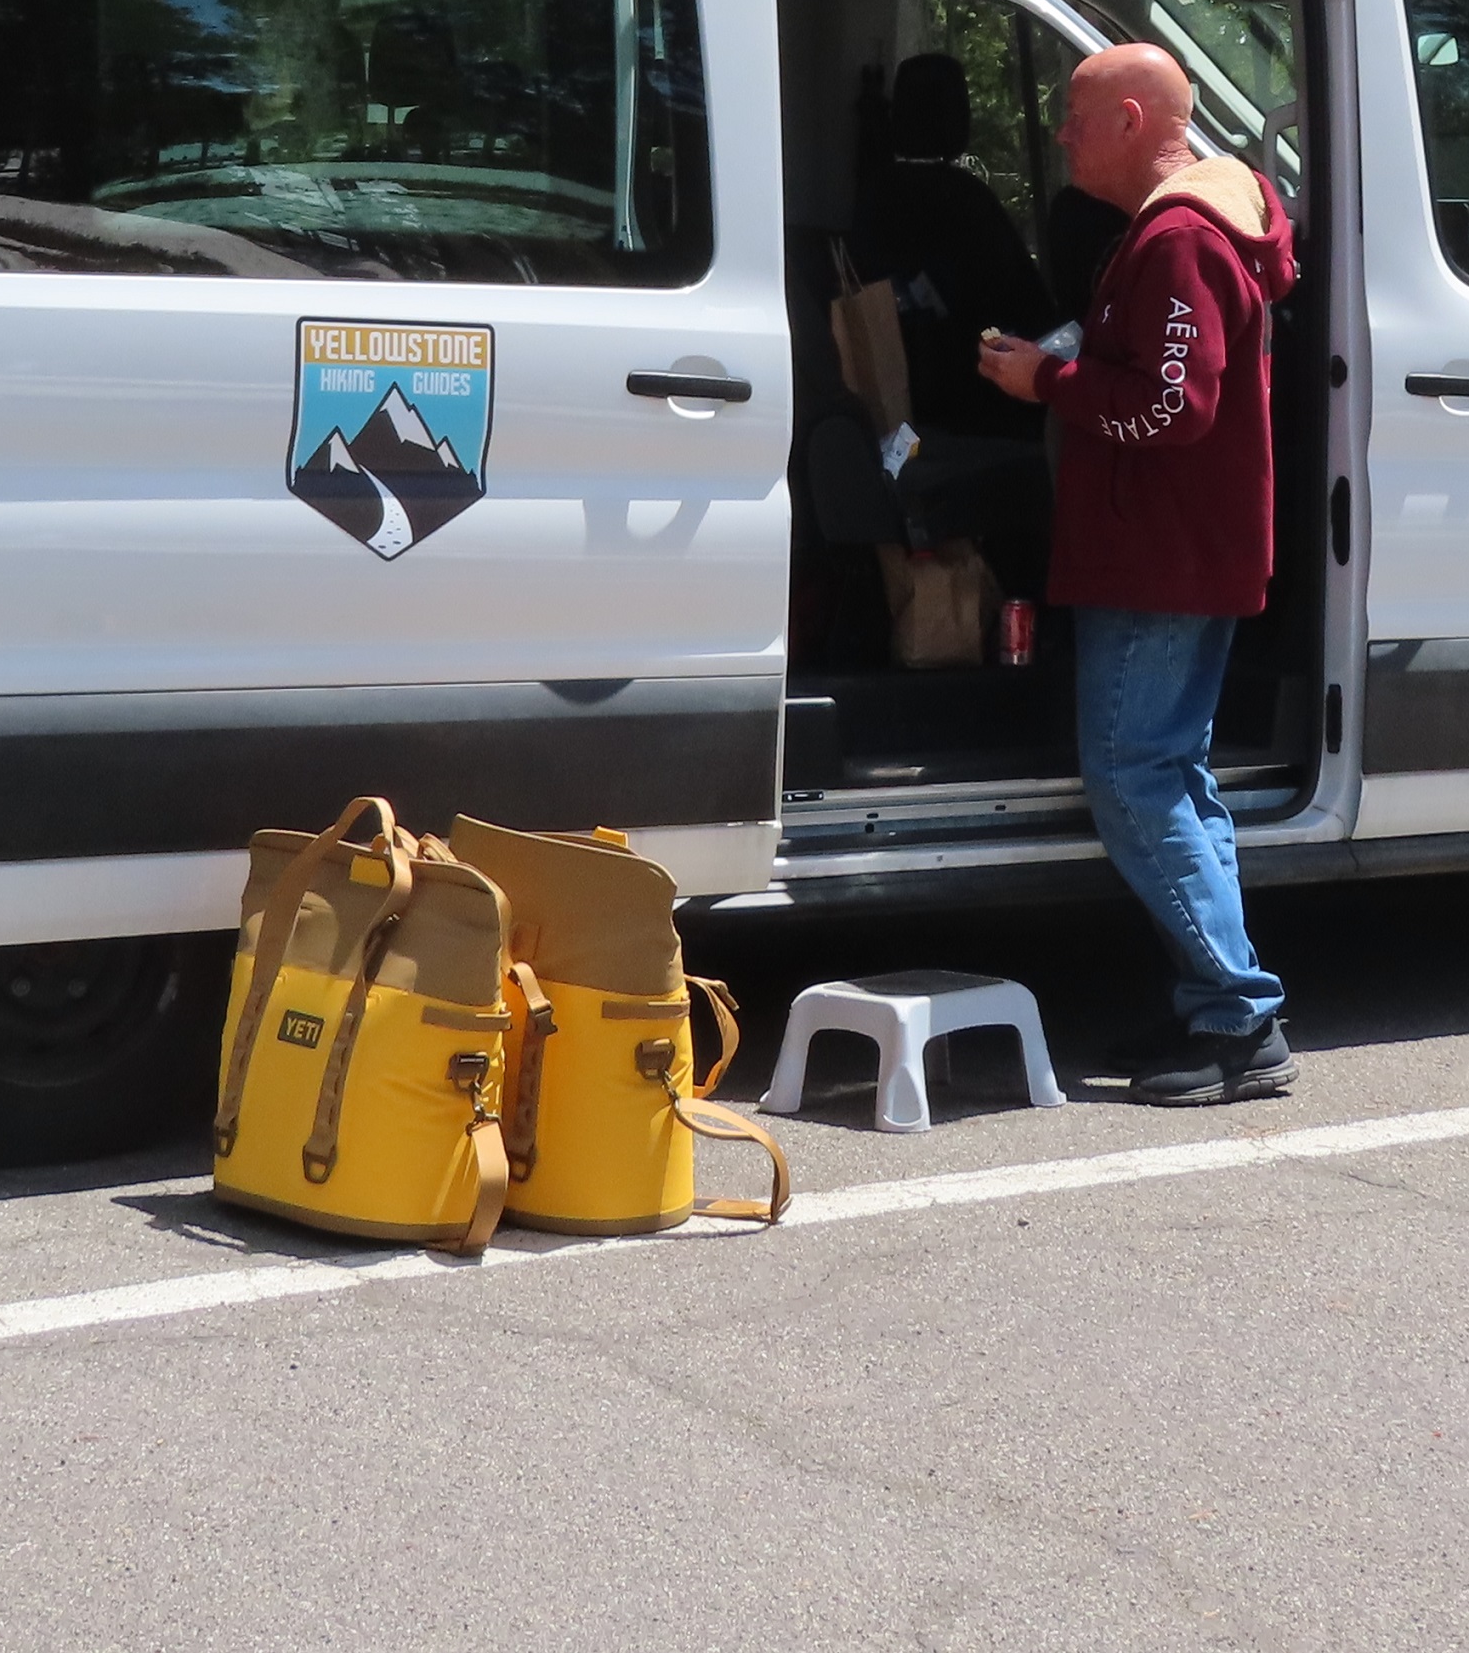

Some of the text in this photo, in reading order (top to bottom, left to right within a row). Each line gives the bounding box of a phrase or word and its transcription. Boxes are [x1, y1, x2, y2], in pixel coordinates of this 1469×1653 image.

[310, 329, 482, 365] YELLOWSTONE
[319, 368, 472, 396] HIKING GUIDES
[285, 1016, 321, 1043] YETI
